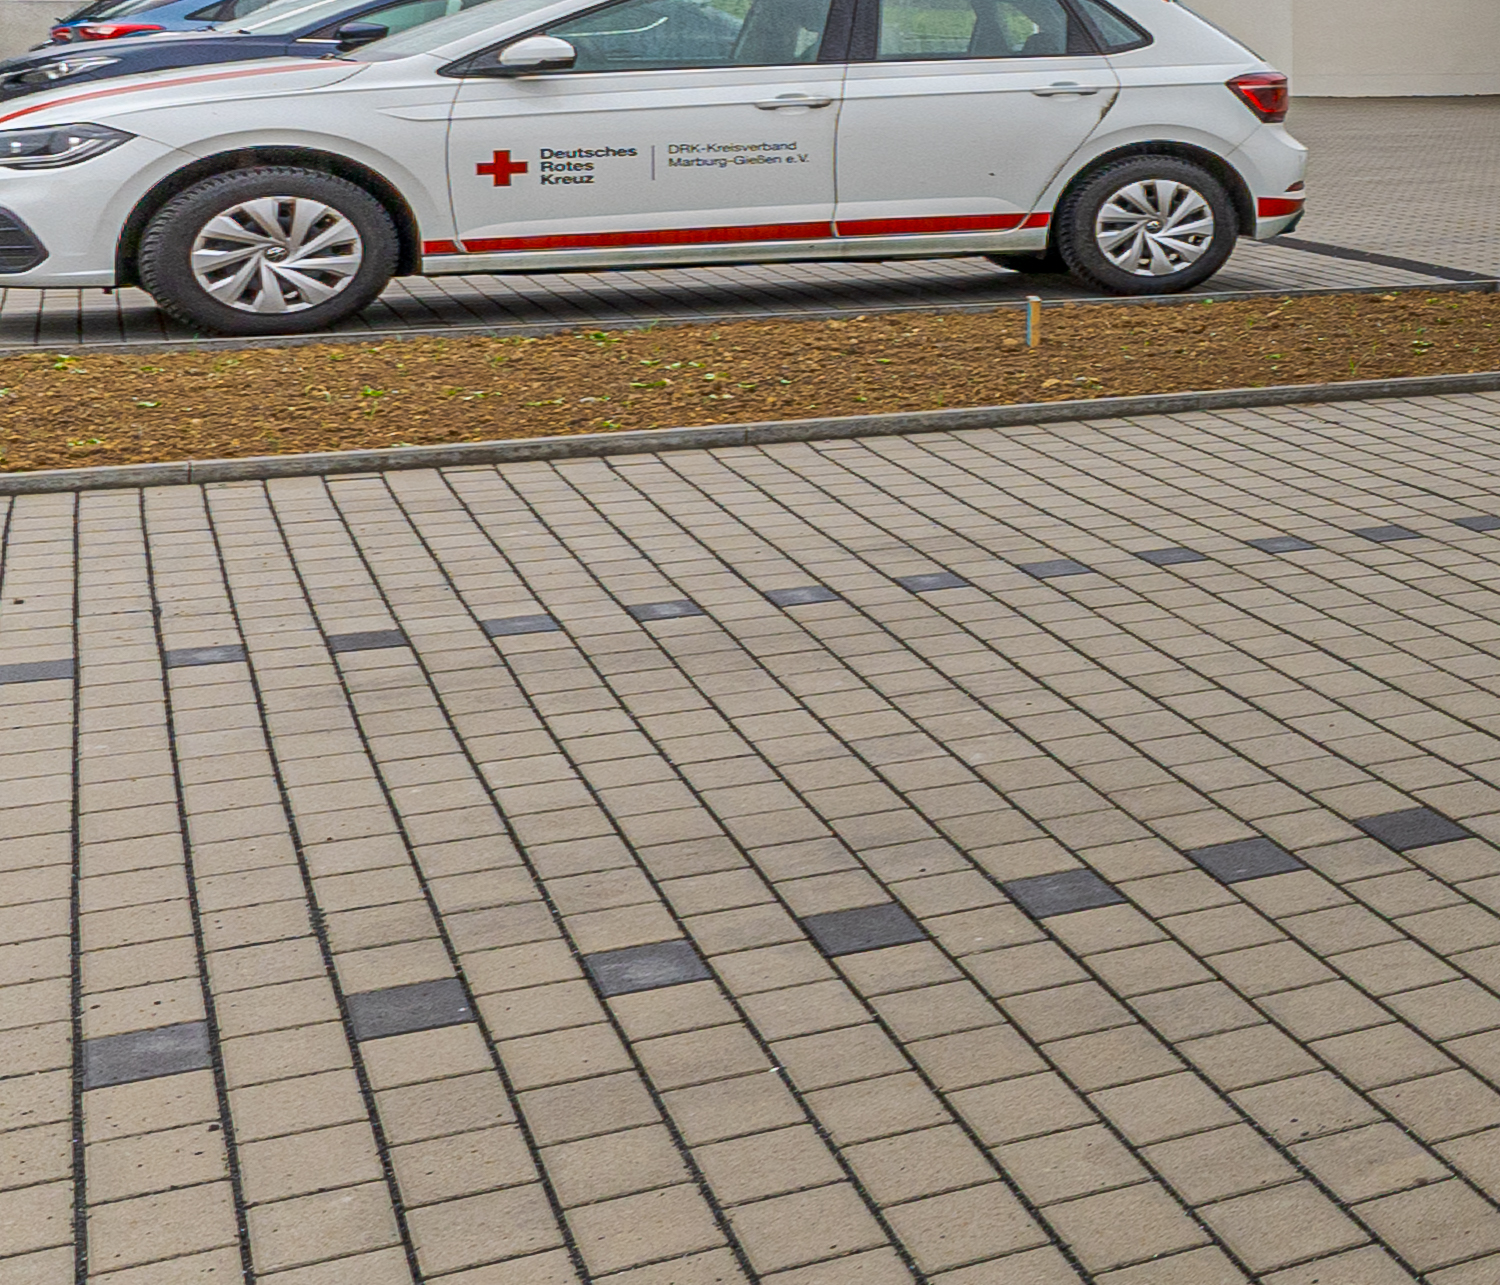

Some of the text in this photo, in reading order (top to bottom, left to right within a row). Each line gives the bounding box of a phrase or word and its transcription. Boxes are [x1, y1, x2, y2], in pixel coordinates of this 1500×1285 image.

[540, 146, 638, 159] Deutsches
[668, 141, 797, 154] DRK-Kreisverband
[785, 153, 810, 164] e.V.
[540, 161, 595, 172] Rotes
[540, 174, 595, 185] Kreuz
